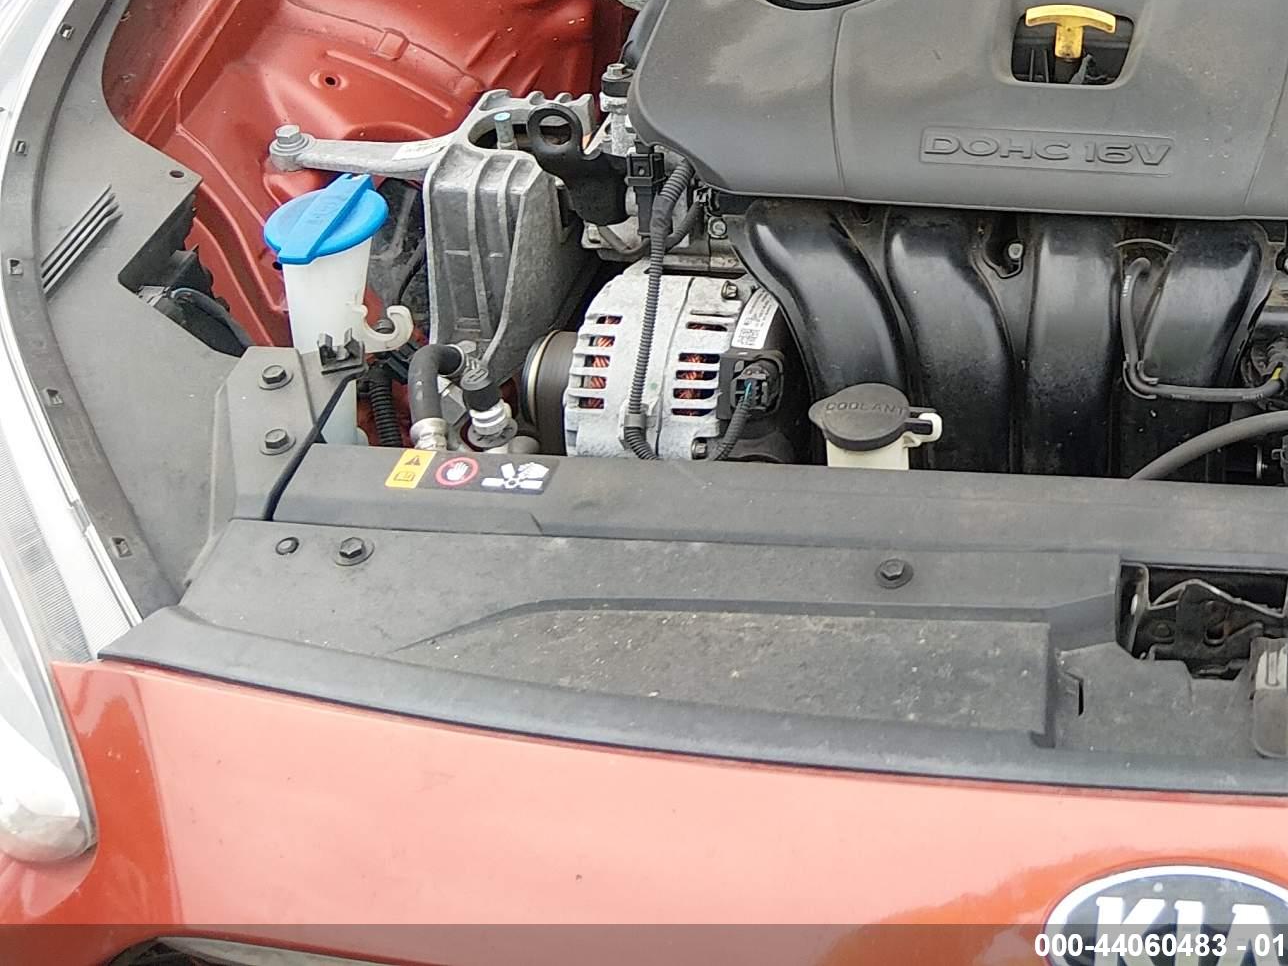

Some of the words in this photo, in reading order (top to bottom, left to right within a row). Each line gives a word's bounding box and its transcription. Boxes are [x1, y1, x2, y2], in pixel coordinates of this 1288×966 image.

[923, 135, 1072, 161] DOHC
[1084, 141, 1172, 166] 16V
[825, 401, 909, 416] COOLANT
[1093, 895, 1284, 966] KIA
